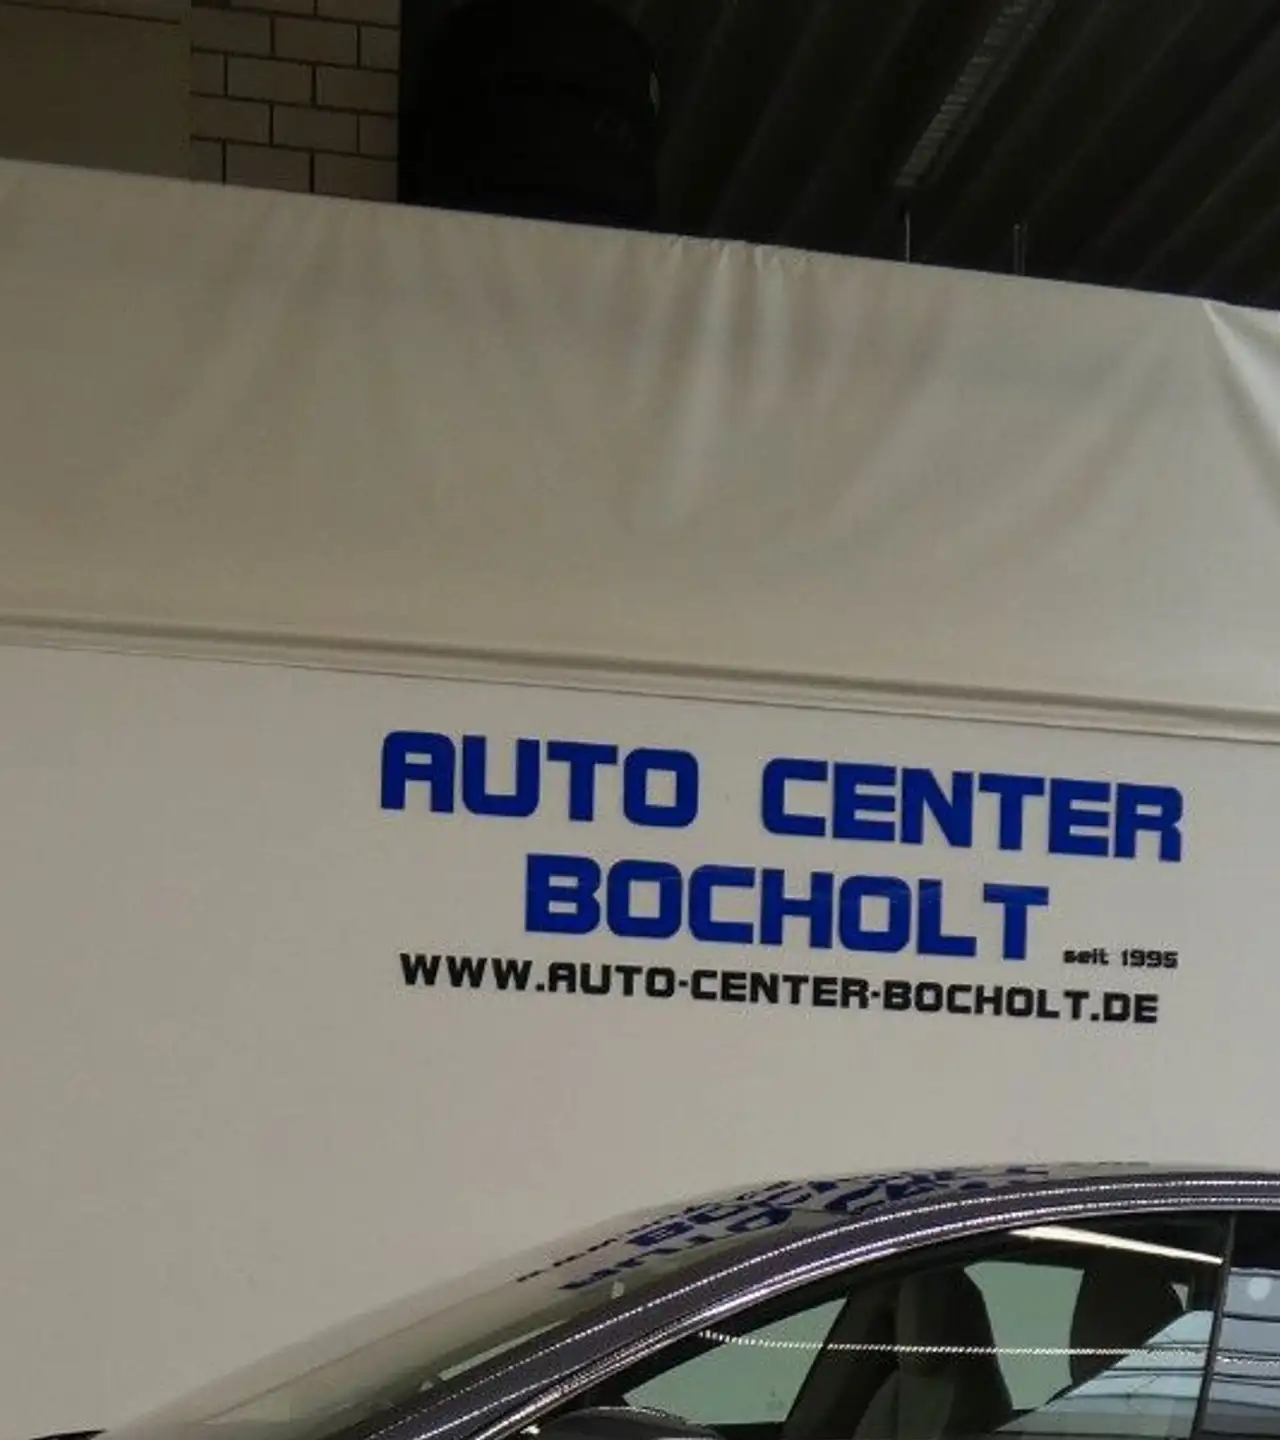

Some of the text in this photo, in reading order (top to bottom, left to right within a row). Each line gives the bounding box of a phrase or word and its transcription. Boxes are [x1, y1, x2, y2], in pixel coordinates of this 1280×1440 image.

[380, 730, 1184, 864] AUTO CENTER
[524, 853, 1179, 969] BOCHOLT seit 1995
[398, 952, 1161, 1025] WWW.AUTO-CENTER-BOCHOLT.DE
